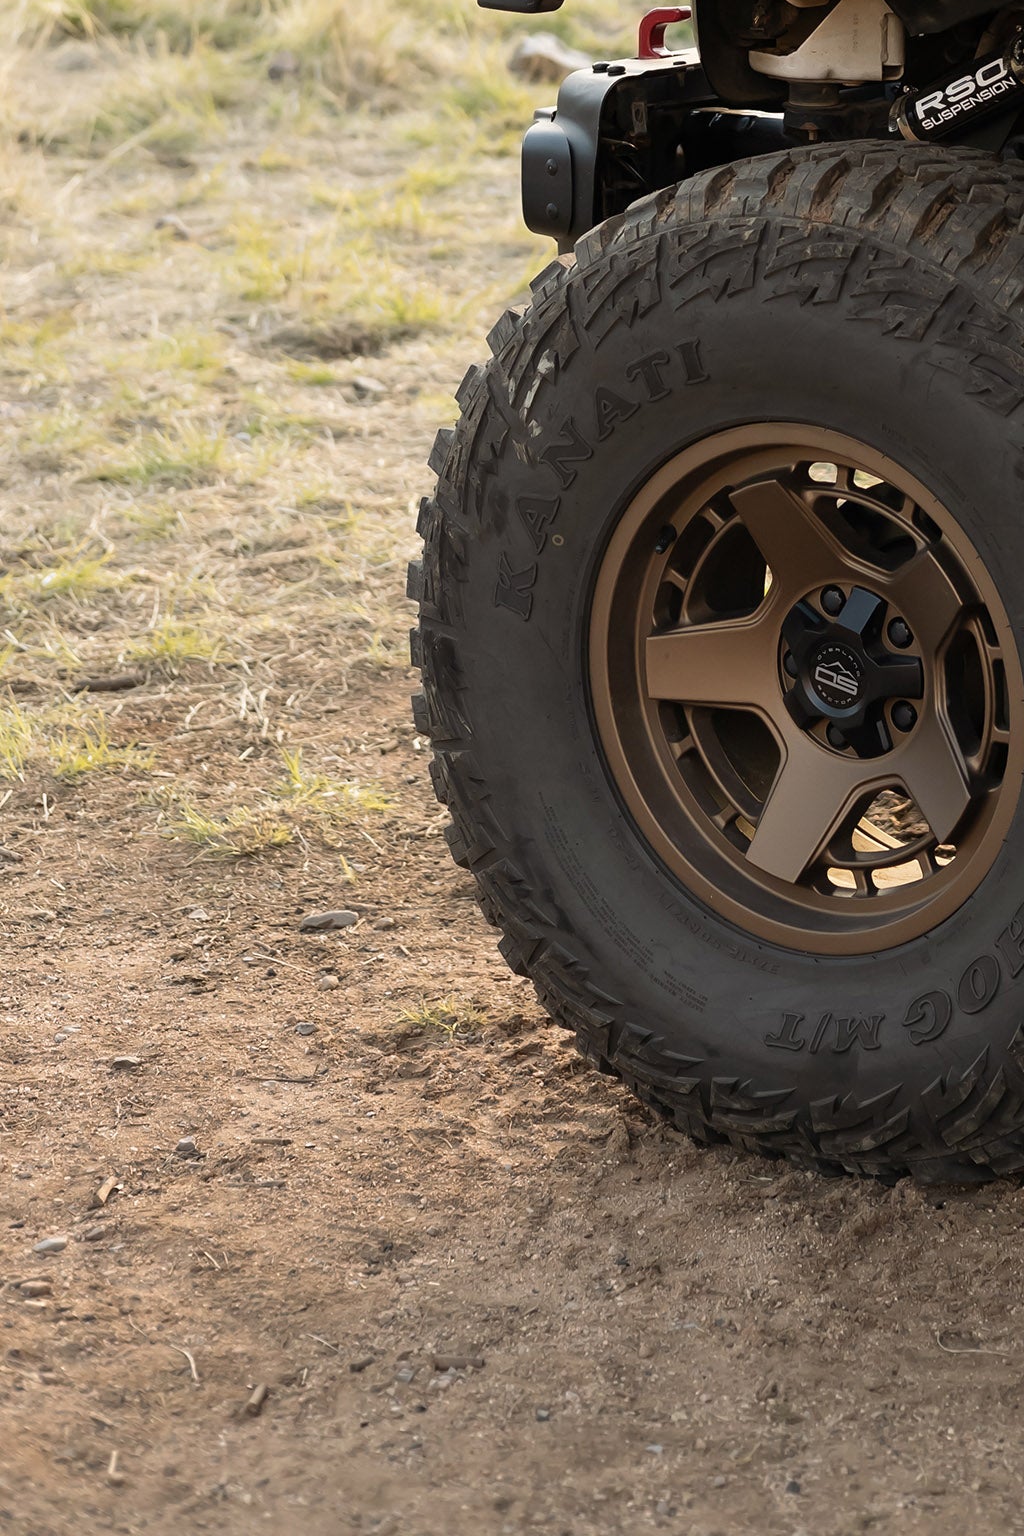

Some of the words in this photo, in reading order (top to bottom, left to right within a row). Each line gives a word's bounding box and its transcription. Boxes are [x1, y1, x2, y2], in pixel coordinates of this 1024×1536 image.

[921, 76, 1017, 131] SUSPENSION
[494, 336, 711, 622] KANATI
[762, 1009, 886, 1056] M/T
